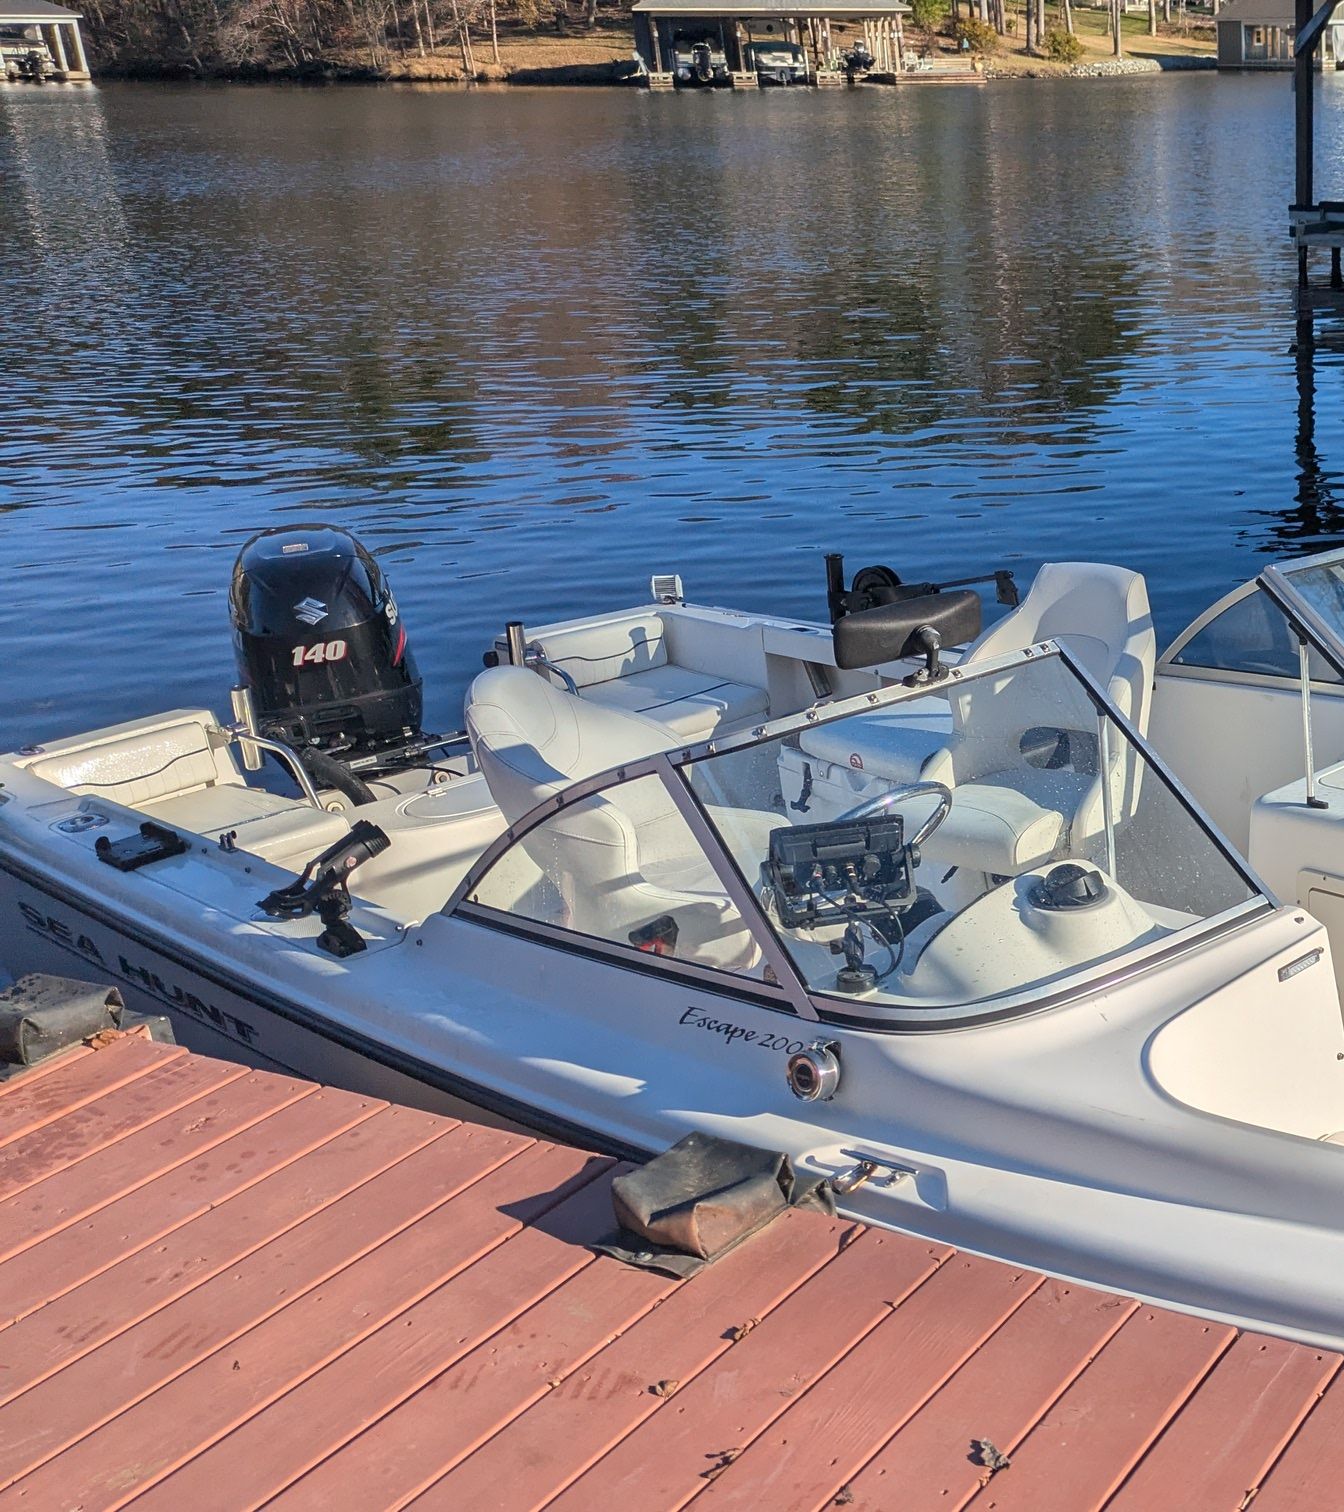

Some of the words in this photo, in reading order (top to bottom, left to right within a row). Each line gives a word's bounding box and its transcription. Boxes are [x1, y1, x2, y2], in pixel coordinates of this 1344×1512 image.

[291, 640, 347, 667] 140
[17, 901, 105, 965] SEA
[117, 955, 260, 1045] HUNT
[679, 1006, 758, 1044] Escape
[758, 1033, 804, 1055] 200
